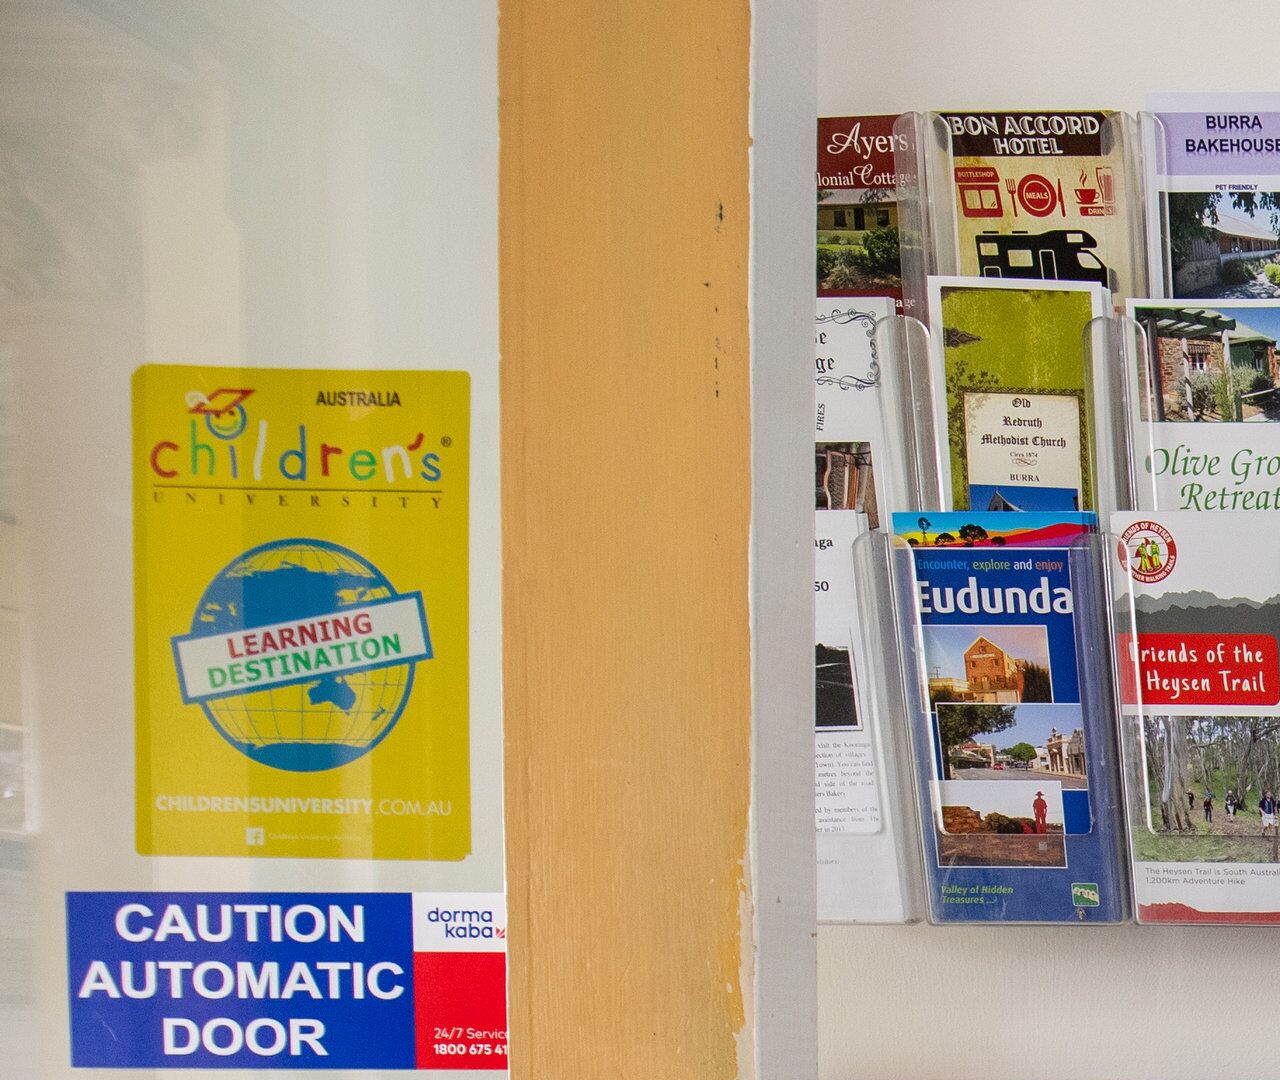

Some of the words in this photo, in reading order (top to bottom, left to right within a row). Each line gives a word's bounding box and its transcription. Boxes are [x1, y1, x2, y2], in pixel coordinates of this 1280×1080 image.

[949, 116, 999, 136] BON
[1005, 116, 1099, 136] ACCORD
[1206, 116, 1262, 129] BURRA
[993, 137, 1063, 155] HOTEL
[316, 391, 401, 407] AUSTRALIA
[1149, 447, 1220, 478] Olive
[1010, 473, 1040, 482] BURRA
[153, 492, 441, 509] UNIVERSITY
[917, 576, 1073, 616] Eudunda
[227, 614, 373, 659] LEARNING
[207, 634, 401, 689] DESTINATION
[1206, 643, 1225, 663] of
[1235, 643, 1263, 663] the
[1146, 671, 1210, 700] Heysen
[1218, 671, 1266, 693] Trail
[155, 796, 451, 816] CHILDRENSUNIVERSITY.COM.AU
[115, 904, 364, 943] CAUTION
[427, 908, 493, 924] dorma
[445, 923, 493, 939] kaba
[79, 961, 404, 1000] AUTOMATIC
[163, 1018, 328, 1056] DOOR
[434, 1027, 463, 1039] 24/7
[434, 1044, 466, 1054] 1800
[469, 1044, 491, 1054] 675
